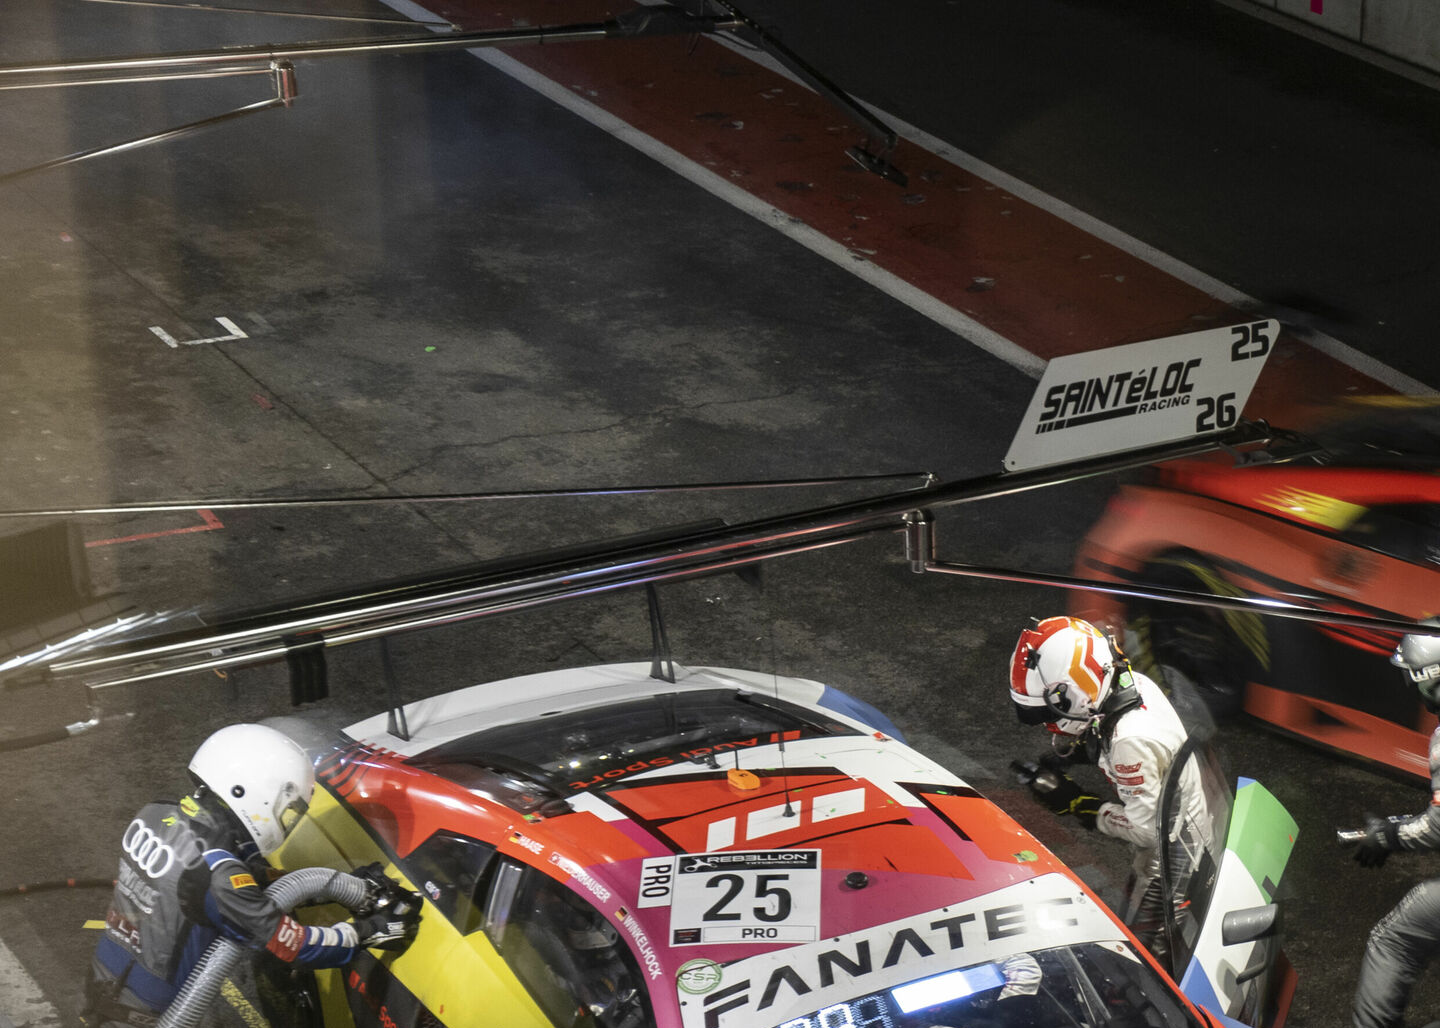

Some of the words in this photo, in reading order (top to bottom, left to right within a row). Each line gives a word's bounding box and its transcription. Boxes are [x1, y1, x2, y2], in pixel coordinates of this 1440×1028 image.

[1231, 321, 1269, 362] 25
[1138, 394, 1190, 415] RACING
[1196, 392, 1236, 433] 26
[569, 756, 674, 790] Sport
[519, 836, 545, 855] HAASE
[642, 864, 672, 898] PRO
[703, 873, 792, 922] 25
[623, 914, 663, 980] WINKELHOCK
[741, 928, 778, 939] PRO
